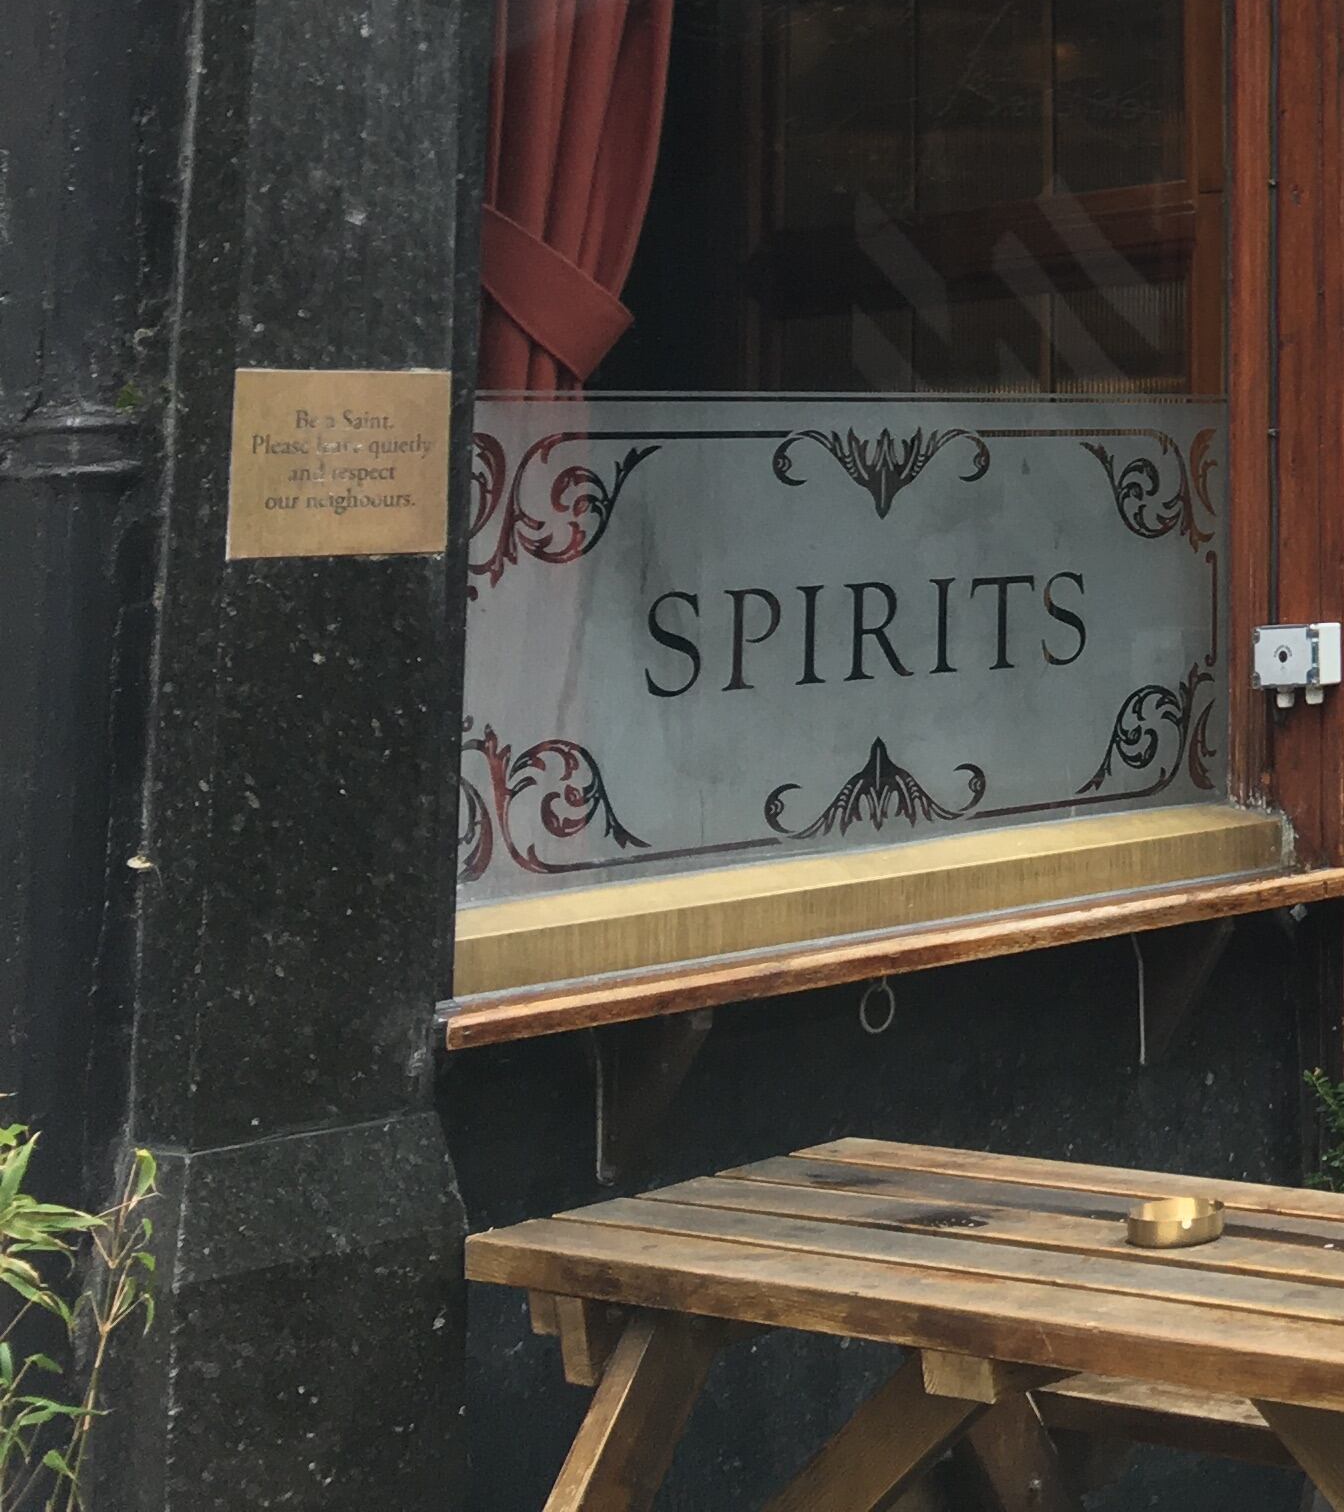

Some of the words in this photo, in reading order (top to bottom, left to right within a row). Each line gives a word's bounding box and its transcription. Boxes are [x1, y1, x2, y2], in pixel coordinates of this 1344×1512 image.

[295, 410, 316, 429] Be
[252, 435, 309, 455] Please
[368, 434, 432, 460] quietly
[288, 461, 325, 481] and
[331, 465, 395, 487] respect
[265, 495, 298, 510] our
[644, 570, 1087, 698] SPIRITS
